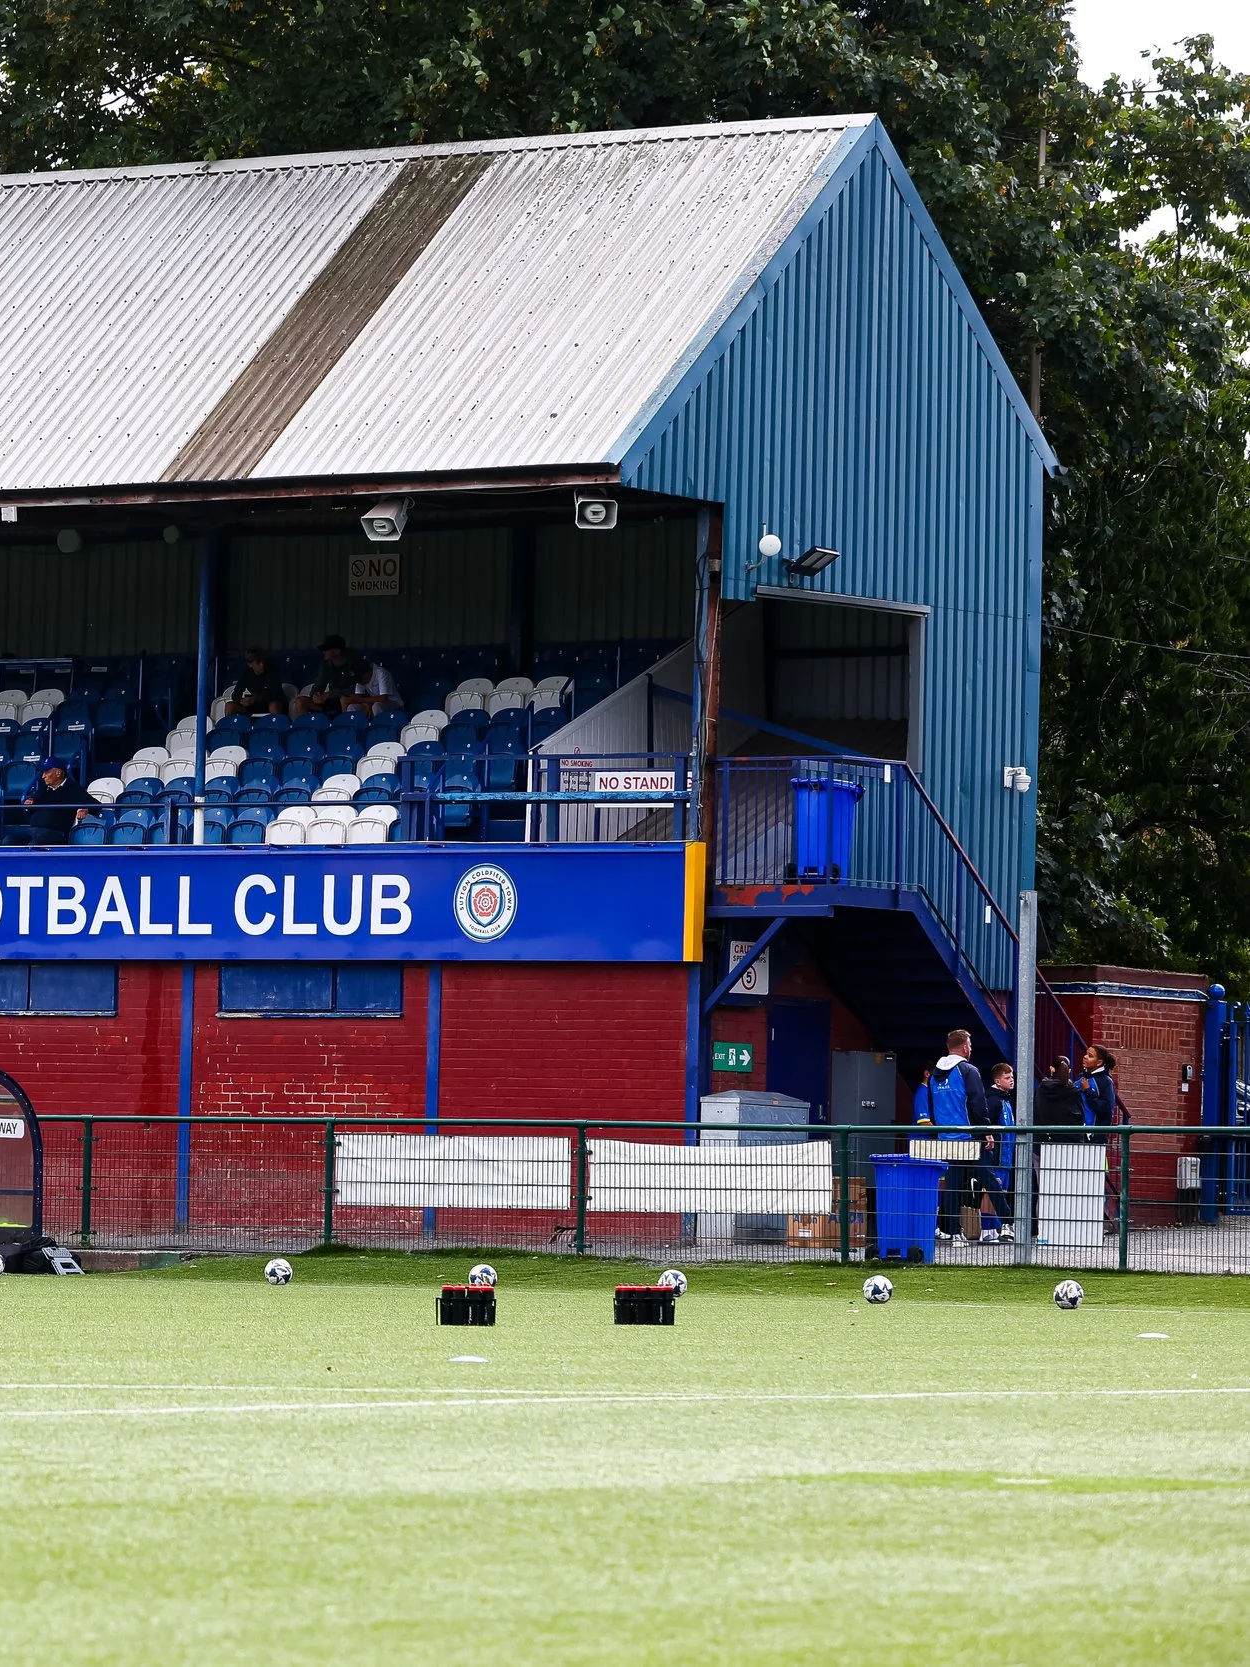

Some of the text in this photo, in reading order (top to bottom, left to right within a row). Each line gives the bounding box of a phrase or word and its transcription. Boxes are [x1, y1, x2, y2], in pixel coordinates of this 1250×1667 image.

[368, 558, 396, 577] NO
[350, 580, 398, 590] SMOKING
[570, 760, 593, 768] SMOKING
[600, 777, 692, 790] NO STANDIG
[459, 880, 470, 910] SUTTON
[472, 870, 506, 884] COLDFIELD
[235, 875, 412, 935] CLUB
[468, 924, 501, 934] FOOTBALL CLUB
[746, 972, 752, 984] 5
